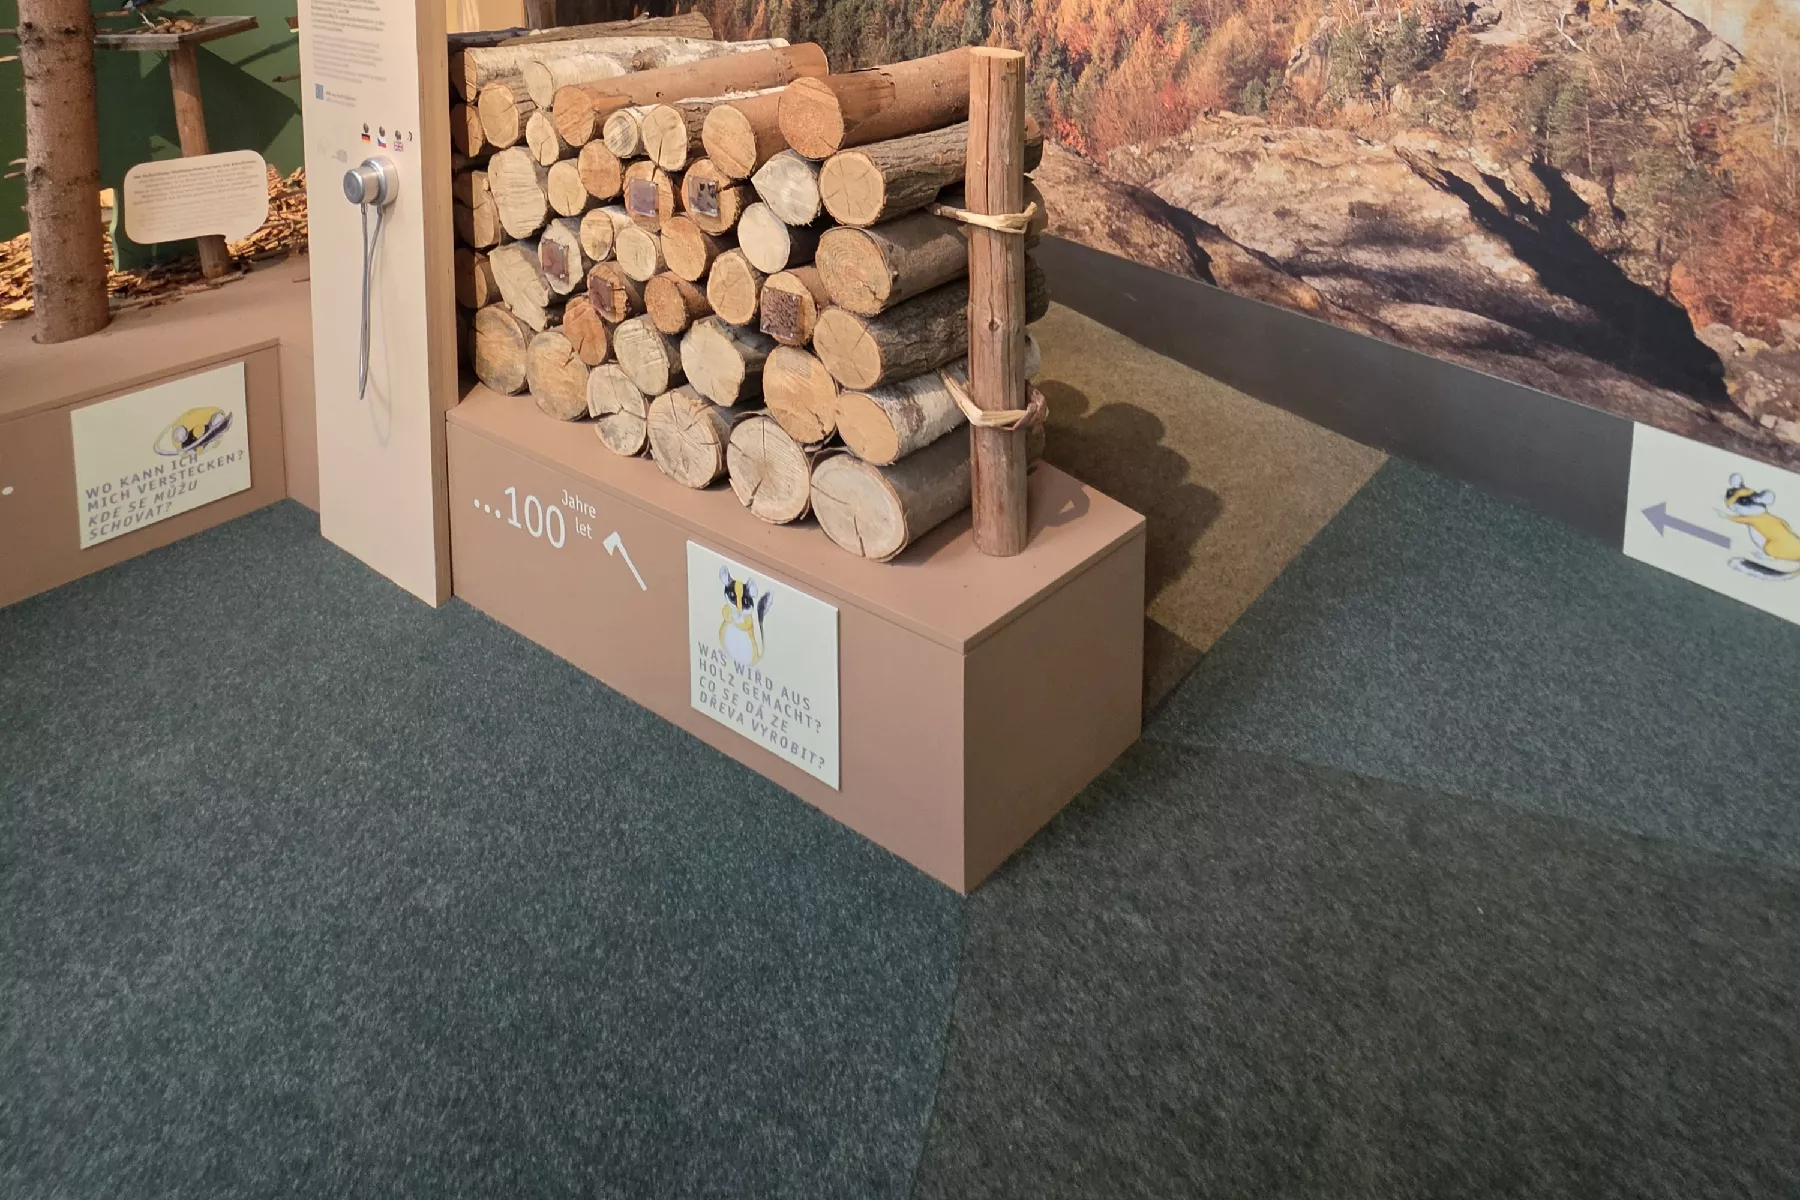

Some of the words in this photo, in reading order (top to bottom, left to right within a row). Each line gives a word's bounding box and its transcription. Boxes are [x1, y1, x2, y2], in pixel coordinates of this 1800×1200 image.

[86, 481, 112, 499] WO
[120, 465, 164, 488] KANN
[171, 454, 198, 471] ICH
[87, 485, 131, 512] MICH
[138, 450, 244, 495] VERSTECKEN?
[88, 507, 121, 528] KDE
[128, 496, 147, 514] SE
[89, 501, 173, 541] SCHOVAT?
[561, 489, 596, 519] Jahre
[575, 517, 593, 539] let
[698, 641, 728, 667] WAS
[734, 660, 773, 691] WIRD
[781, 685, 810, 711] AUS
[700, 658, 735, 687] HOLZ
[742, 681, 822, 734] GEMACHT?
[700, 675, 716, 693] CO
[722, 689, 739, 706] SE
[746, 700, 764, 720] DÁ
[770, 715, 788, 734] ZE
[700, 690, 744, 725] DŘEVA
[751, 718, 825, 770] VYROBIT?
